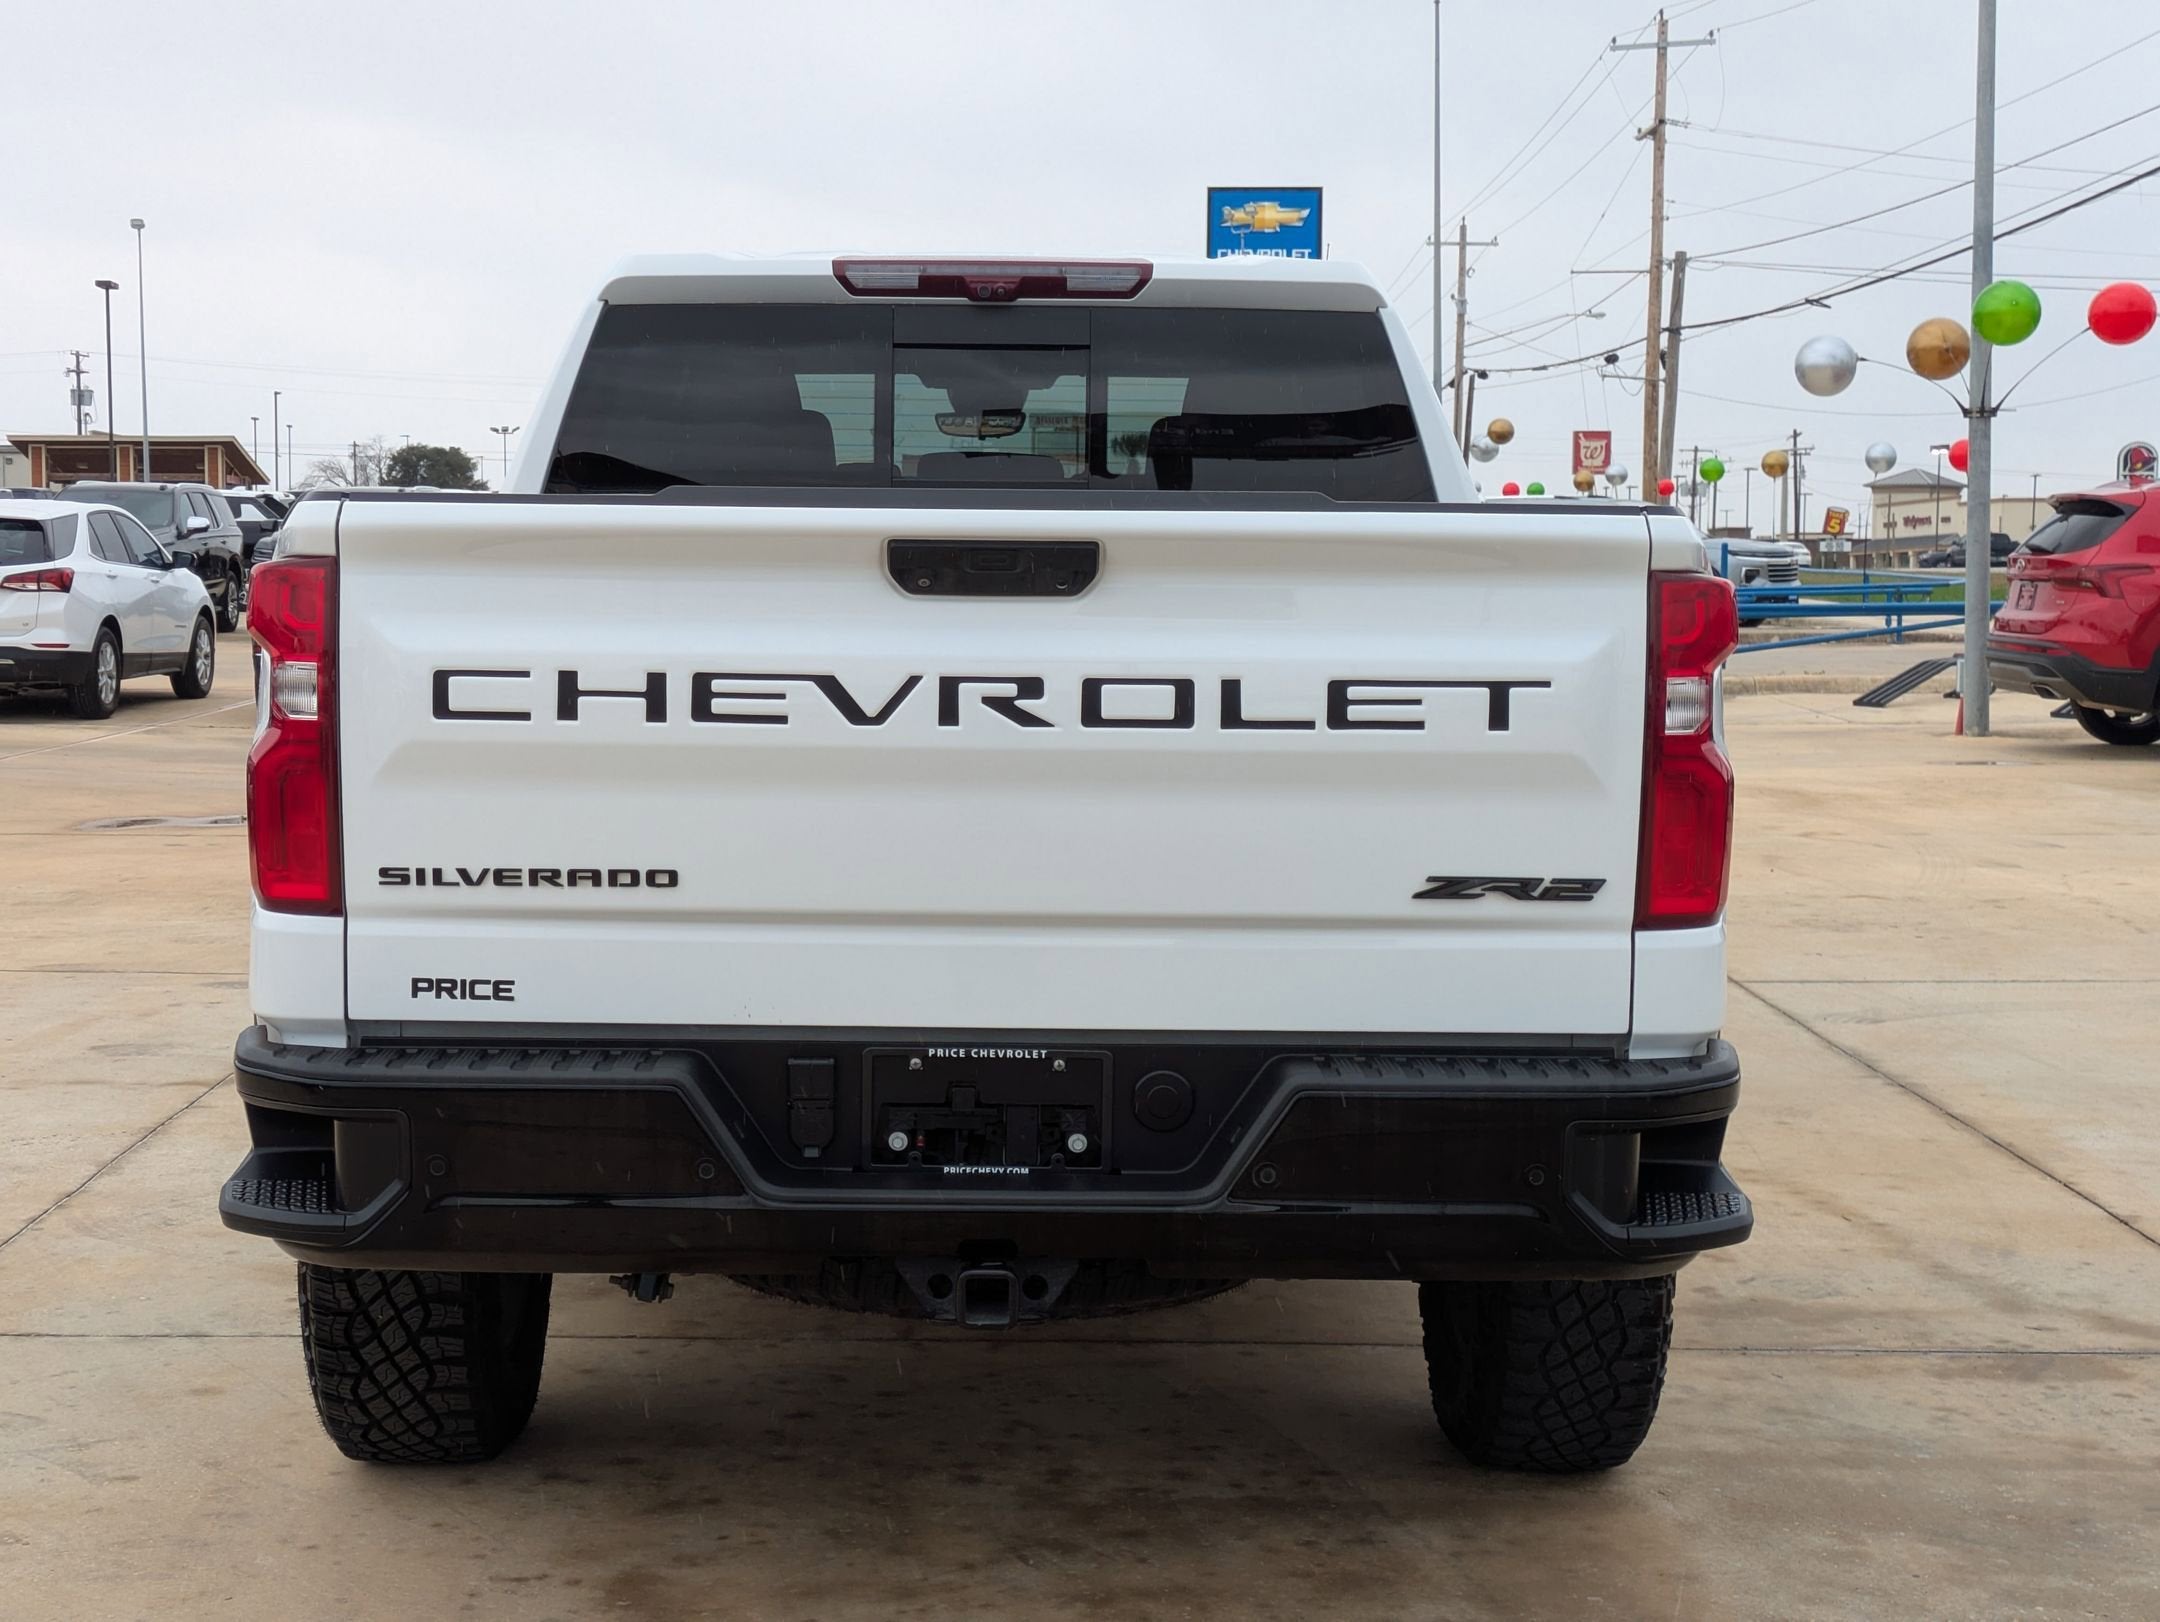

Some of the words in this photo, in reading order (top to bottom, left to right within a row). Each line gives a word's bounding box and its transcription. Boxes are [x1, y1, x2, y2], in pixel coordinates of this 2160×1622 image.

[1827, 519, 1841, 533] 5
[432, 669, 1552, 732] CHEVROLET
[378, 866, 679, 889] SILVERADO
[1411, 876, 1608, 901] ZR2
[411, 977, 516, 1002] PRICE
[928, 1048, 966, 1058] PRICE
[971, 1049, 1048, 1059] CHEVROLET
[943, 1166, 1030, 1174] PRICECHEVYCOM
